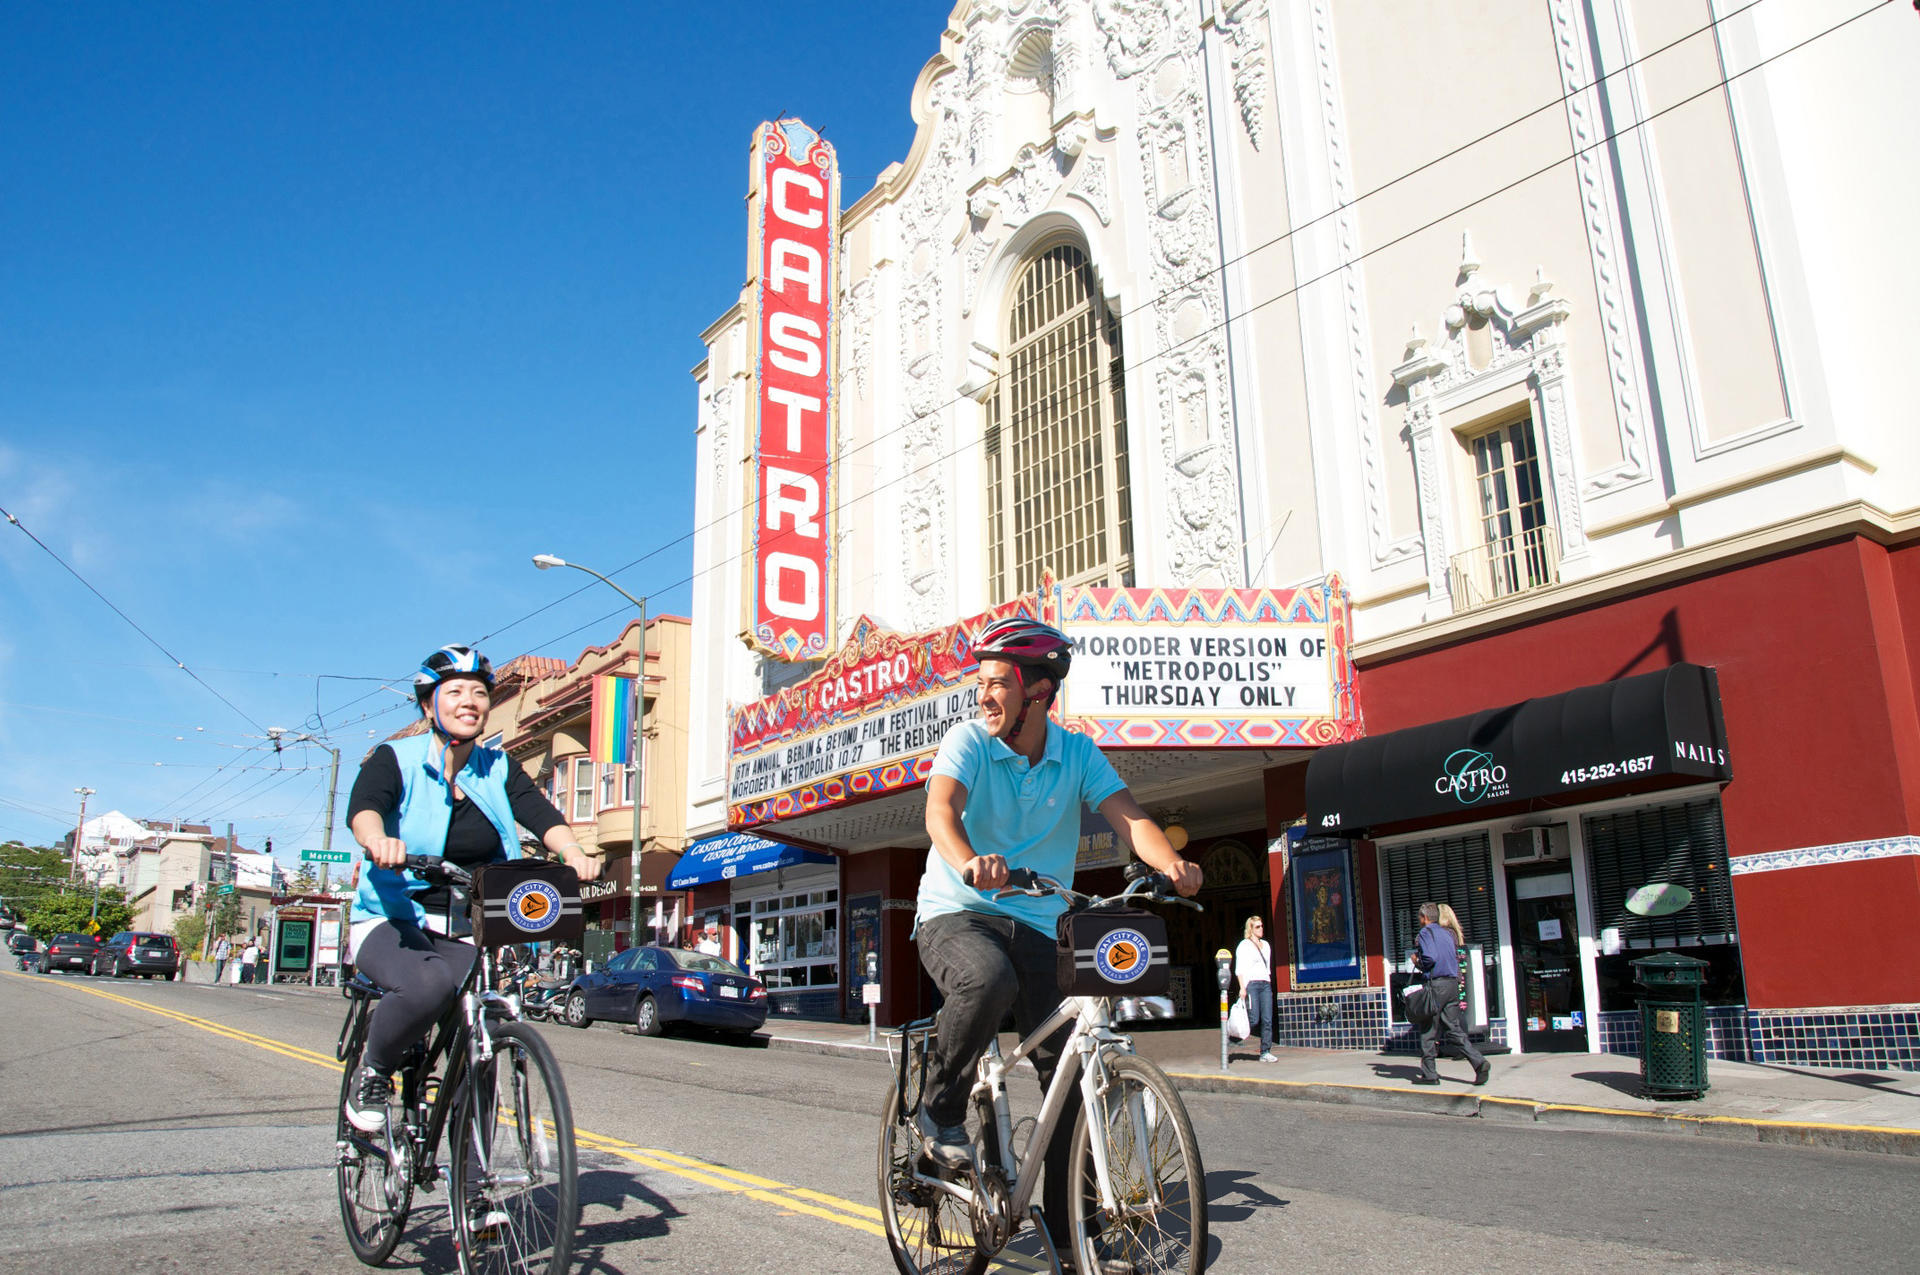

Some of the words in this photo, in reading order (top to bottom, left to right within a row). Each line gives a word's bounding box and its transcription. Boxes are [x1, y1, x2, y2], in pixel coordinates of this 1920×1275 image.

[765, 167, 824, 622] CASTRO
[1071, 636, 1180, 656] MORODER
[1190, 637, 1288, 657] VERSION
[1300, 637, 1326, 658] OF
[821, 653, 910, 709] CASTRO
[1110, 660, 1283, 682] "METROPOLIS"
[1101, 684, 1222, 707] THURSDAY
[1240, 685, 1297, 707] ONLY
[734, 761, 750, 781] 16TH
[752, 752, 781, 776] ANNUAL
[786, 741, 814, 765] BERLIN
[816, 740, 822, 754] &
[826, 727, 859, 751] BEYOND
[862, 718, 885, 740] FILM
[890, 700, 939, 733] FESTIVAL
[731, 774, 776, 800] MORODER'S
[781, 754, 834, 787] METROPOLIS
[880, 733, 902, 757] THE
[905, 727, 925, 750] RED
[1675, 741, 1726, 766] NAILS
[1435, 765, 1507, 794] CASTRO
[1561, 755, 1655, 785] 415-252-1657
[1487, 790, 1510, 799] SALON
[1492, 783, 1510, 791] NAIL
[1321, 813, 1341, 828] 431
[309, 852, 344, 861] Market
[690, 837, 729, 857] CASTRO
[702, 847, 737, 862] CUSTOM
[512, 889, 523, 903] BAY
[525, 883, 542, 891] CITY
[544, 887, 557, 902] BIKE
[579, 886, 591, 900] AIR
[1100, 939, 1111, 954] BAY
[1113, 932, 1131, 940] CITY
[1132, 936, 1146, 952] BIKE
